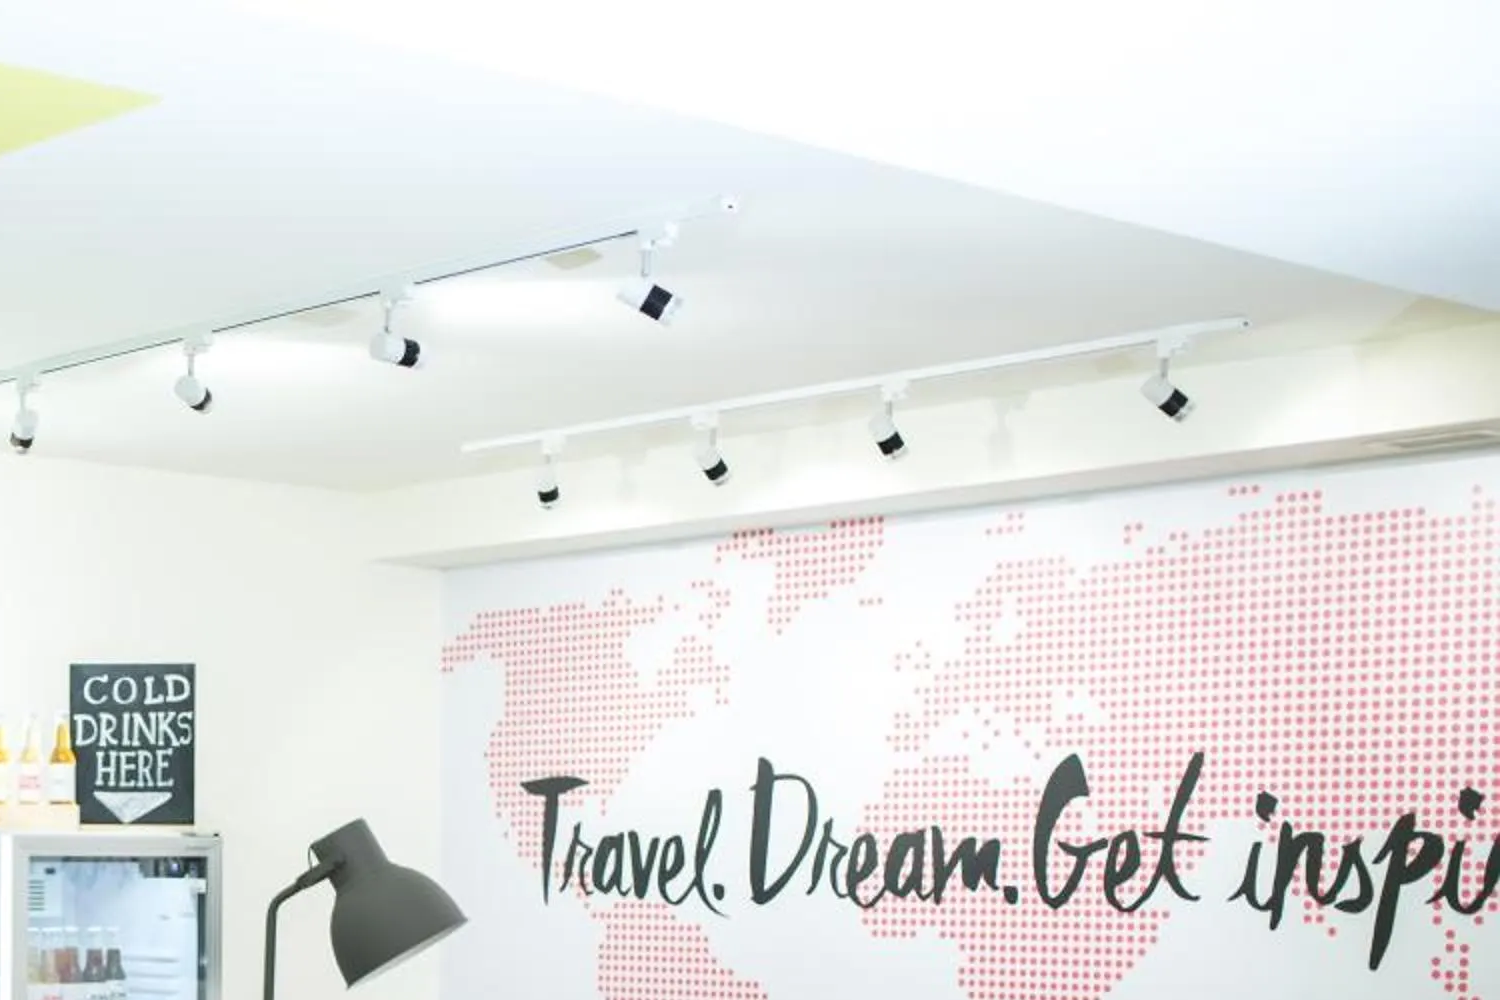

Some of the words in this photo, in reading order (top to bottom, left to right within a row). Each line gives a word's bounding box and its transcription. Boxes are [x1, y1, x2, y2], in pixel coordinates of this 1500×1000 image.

[83, 673, 191, 705] COLD
[74, 711, 192, 747] DRINKS
[95, 749, 174, 788] HERE
[519, 776, 730, 918] Travel.
[750, 757, 1019, 909] Dream.
[1033, 751, 1211, 913] Get
[1228, 786, 1500, 971] inspi
